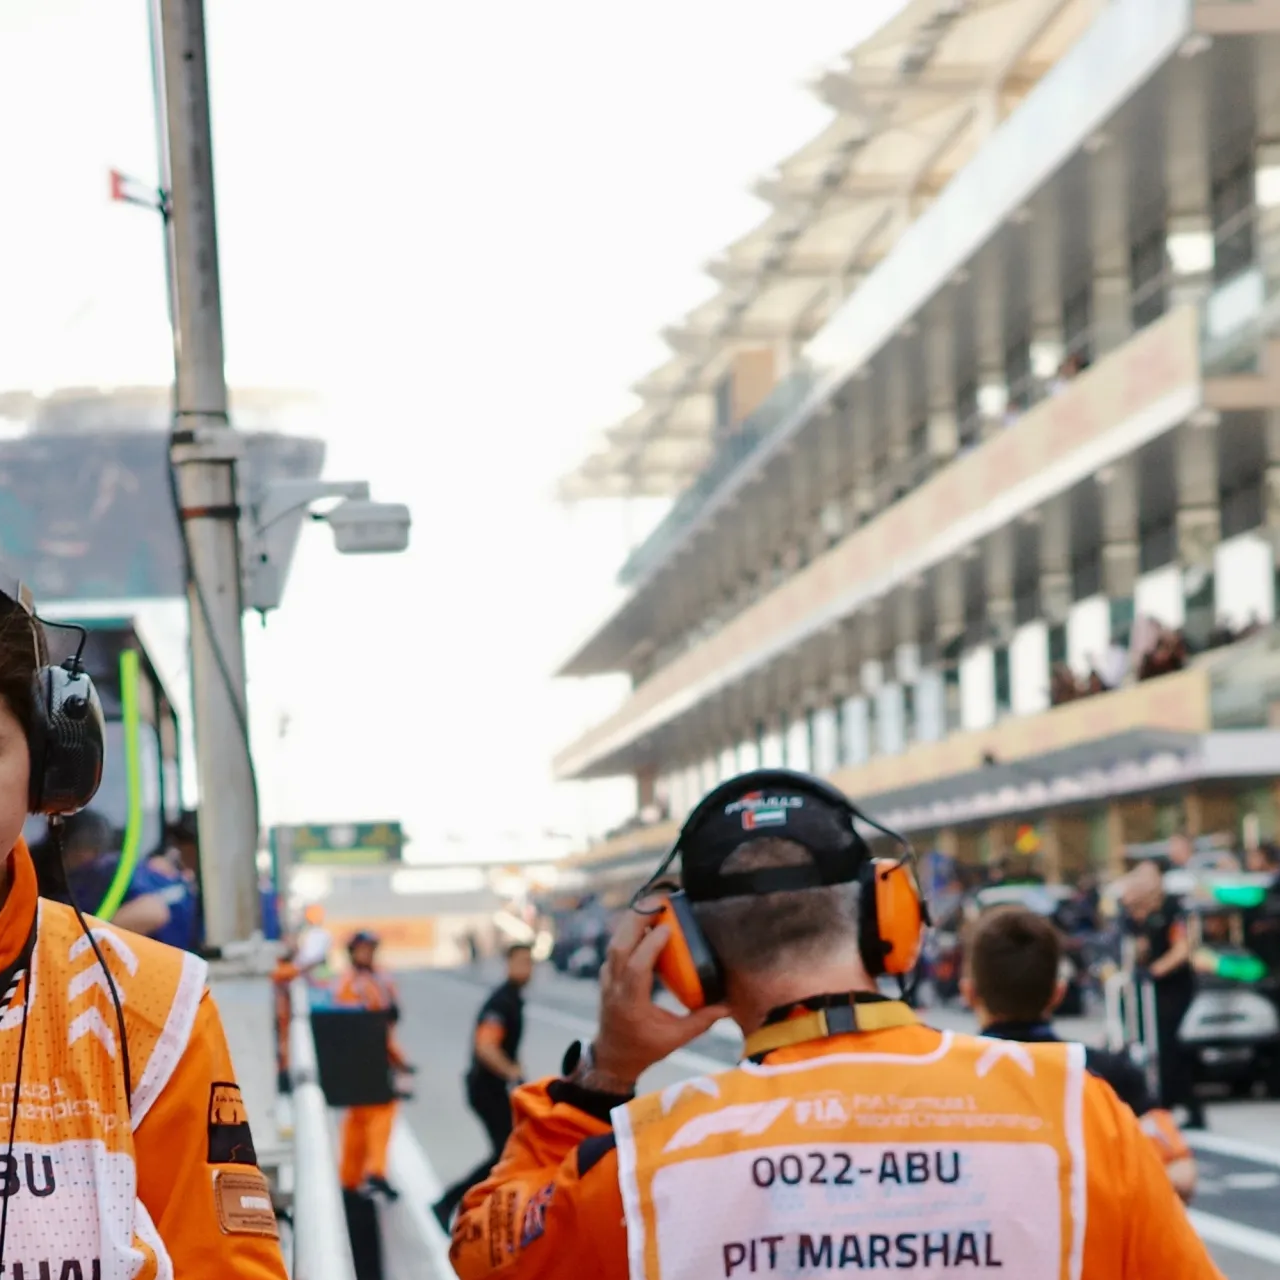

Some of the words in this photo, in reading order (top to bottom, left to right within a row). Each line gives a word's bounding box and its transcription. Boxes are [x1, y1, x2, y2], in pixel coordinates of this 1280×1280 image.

[751, 1150, 962, 1188] 0022-ABU
[722, 1234, 785, 1278] PIT
[797, 1231, 1004, 1270] MARSHAL
